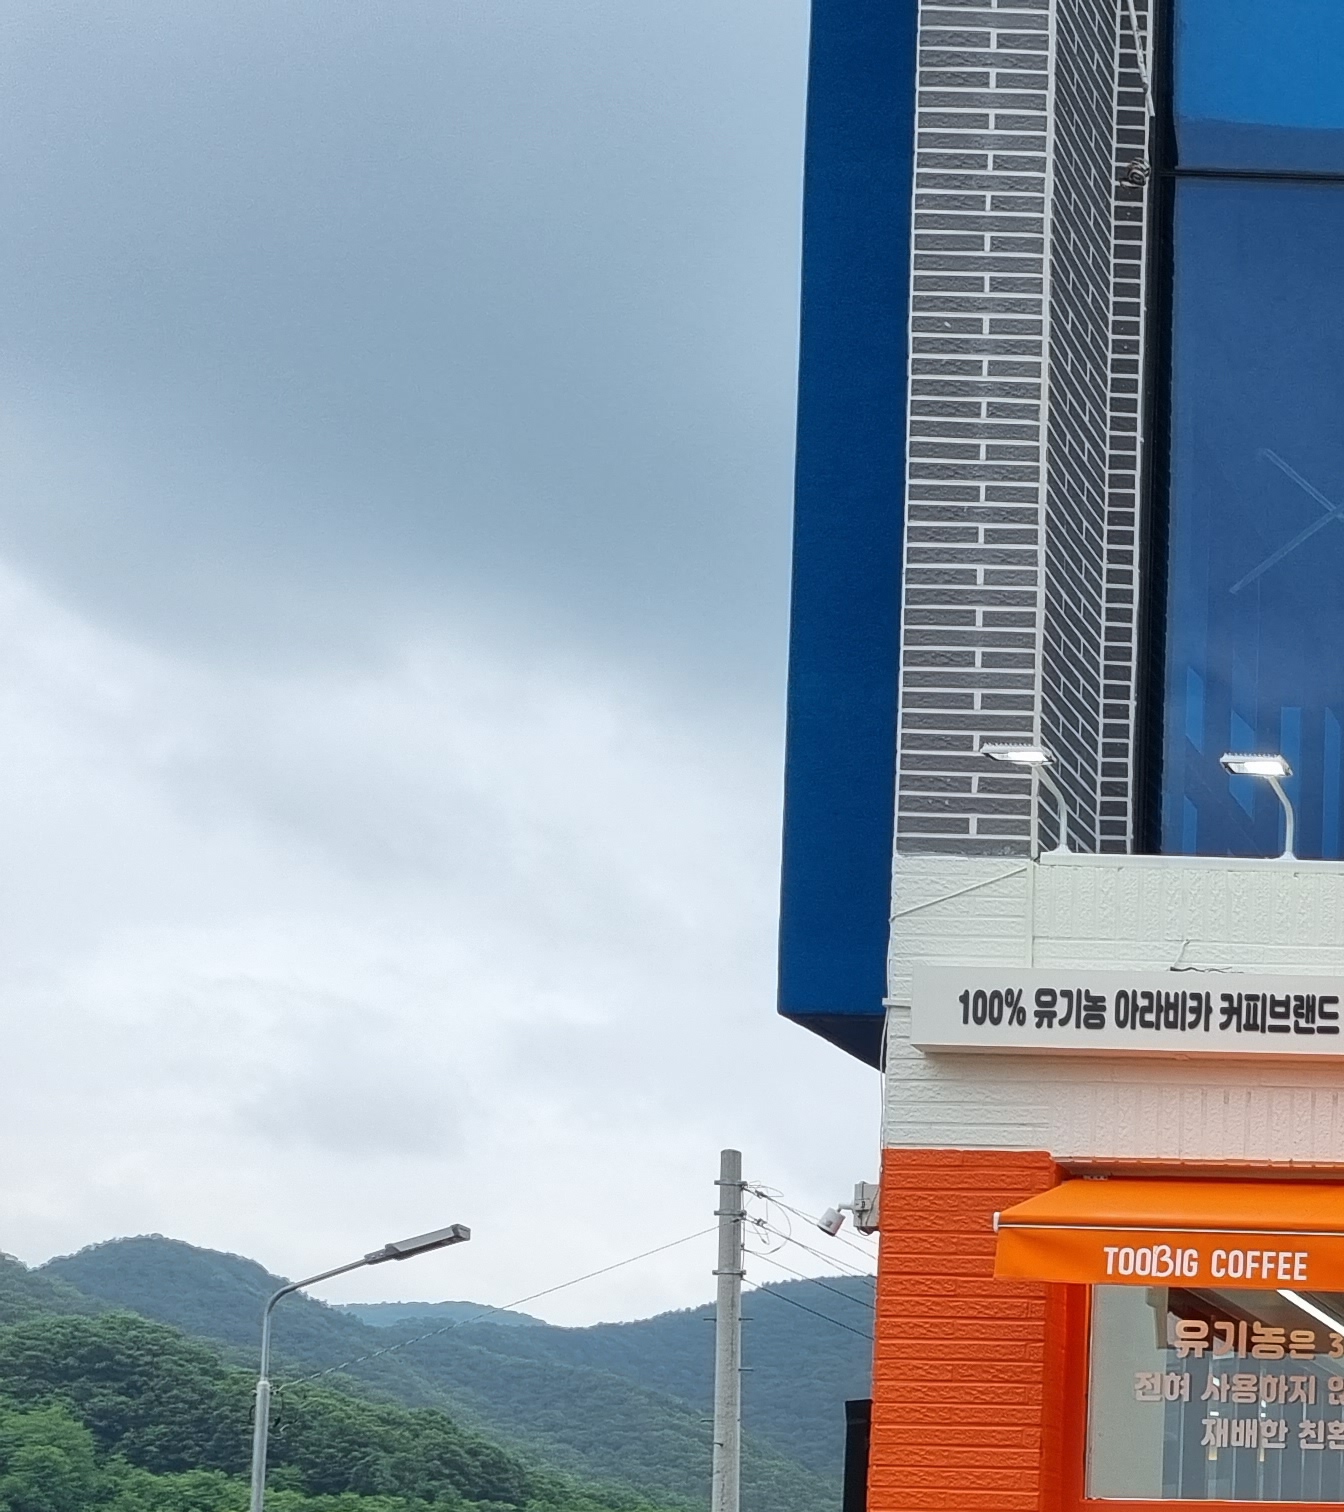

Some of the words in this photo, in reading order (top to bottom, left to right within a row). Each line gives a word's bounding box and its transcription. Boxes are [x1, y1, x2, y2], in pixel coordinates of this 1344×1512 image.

[958, 988, 1027, 1027] 100%
[1032, 988, 1107, 1030] 유기농
[1114, 990, 1213, 1033] 아라비카
[1218, 991, 1341, 1035] 커피브랜드
[1103, 1244, 1199, 1278] TOOBIG
[1211, 1249, 1308, 1281] COFFEE
[1175, 1318, 1316, 1359] 유기농은
[1134, 1371, 1190, 1402] 전혀
[1202, 1373, 1316, 1405] 사용하지
[1201, 1417, 1288, 1449] 재배한
